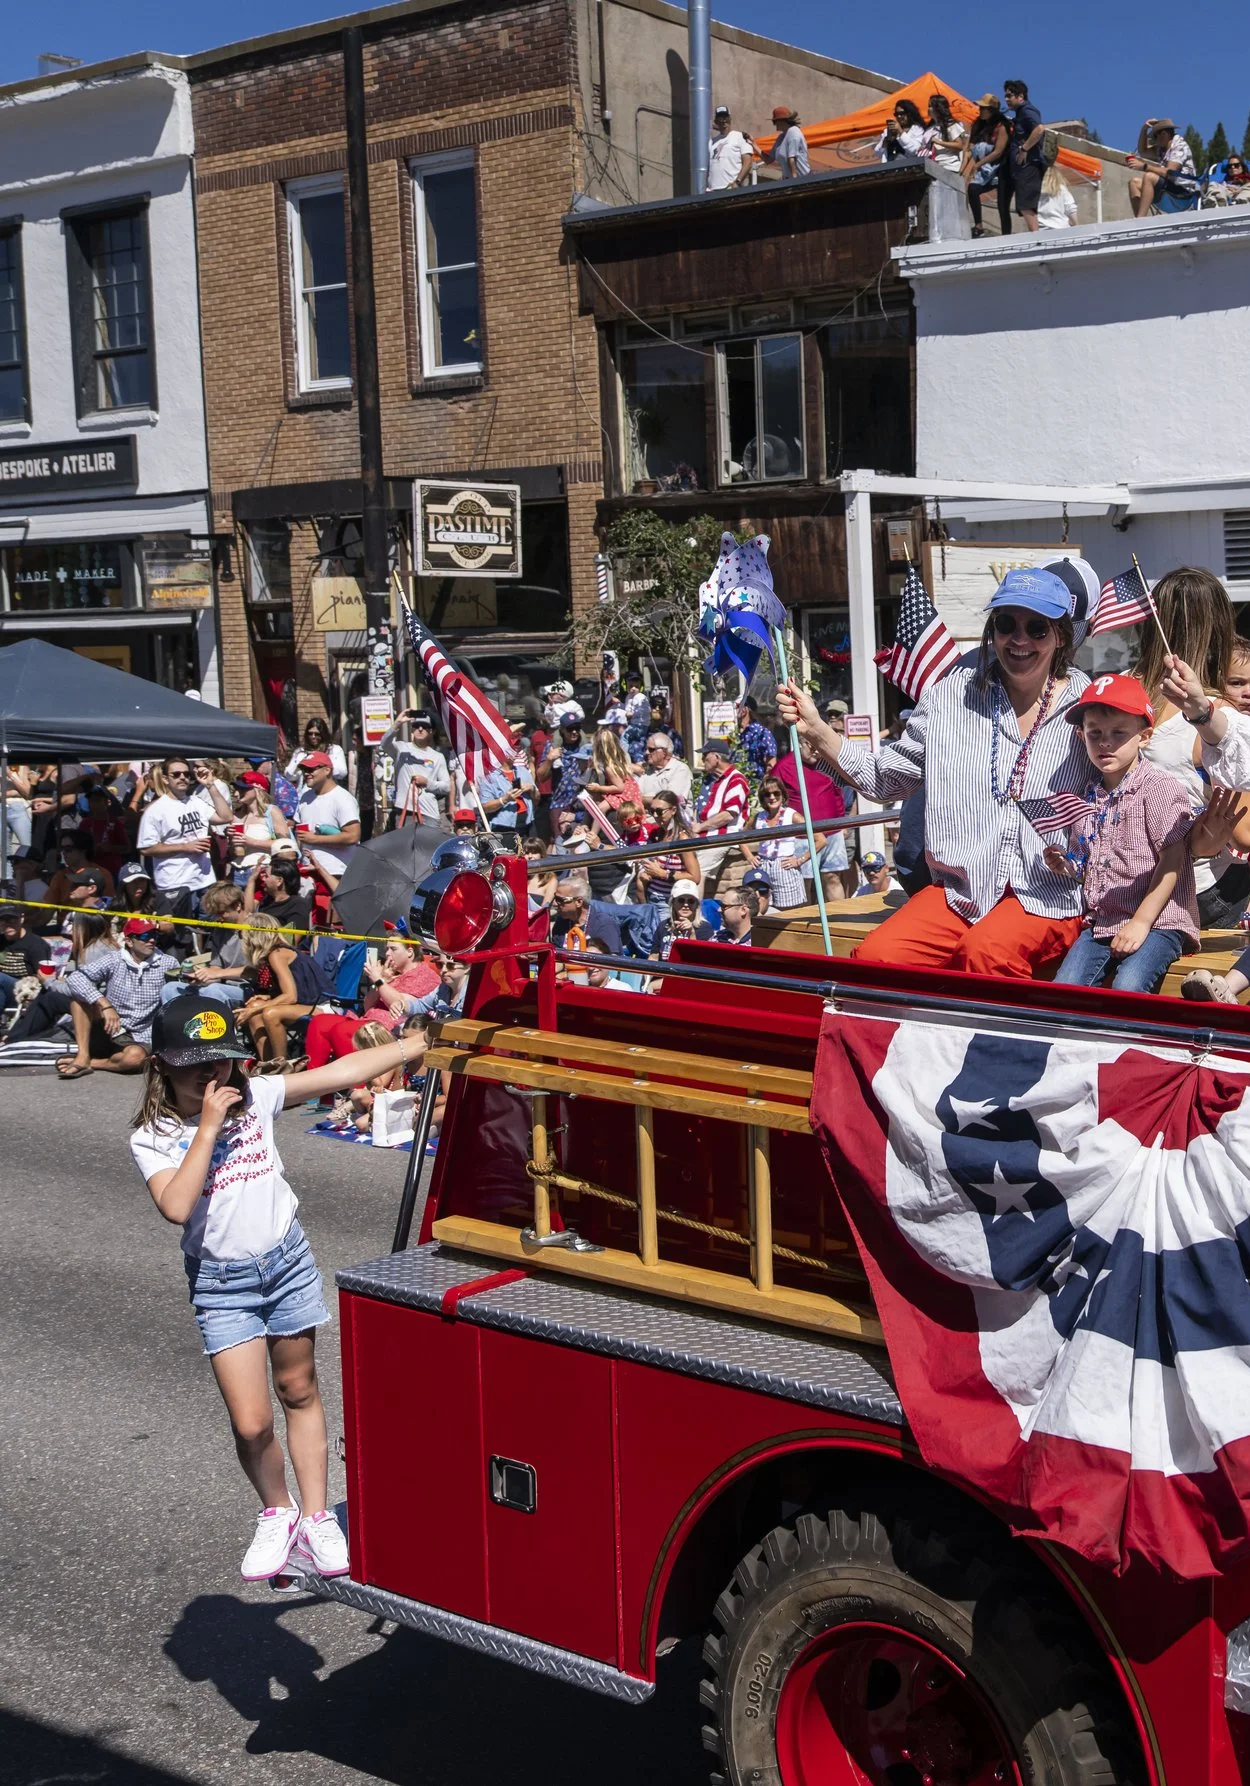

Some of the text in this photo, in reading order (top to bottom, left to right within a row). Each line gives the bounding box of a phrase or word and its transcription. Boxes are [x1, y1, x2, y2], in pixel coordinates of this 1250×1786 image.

[0, 452, 116, 480] ESPOKE ATELIER
[427, 514, 512, 544] PASTIME
[74, 567, 115, 578] MAKER
[203, 1013, 220, 1021] Bass
[744, 1652, 773, 1719] 9.00-20
